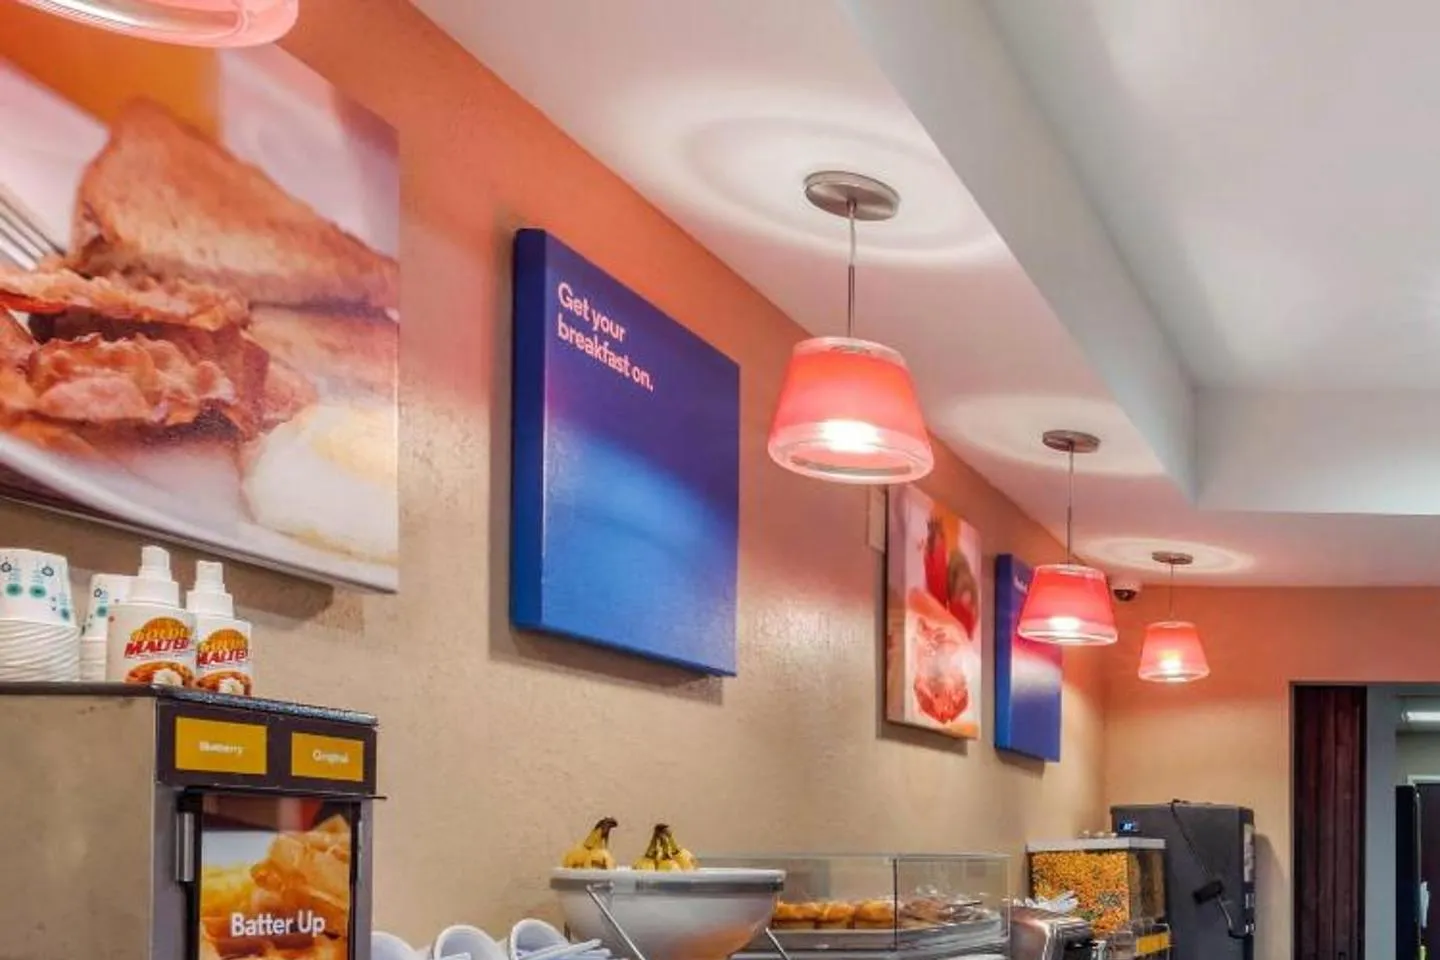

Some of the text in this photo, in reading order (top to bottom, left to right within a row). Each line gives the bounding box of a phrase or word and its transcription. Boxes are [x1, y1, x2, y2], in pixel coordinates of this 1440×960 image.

[557, 281, 627, 342] Get your
[557, 312, 654, 391] breakfast on.
[230, 908, 326, 938] Batter Up
